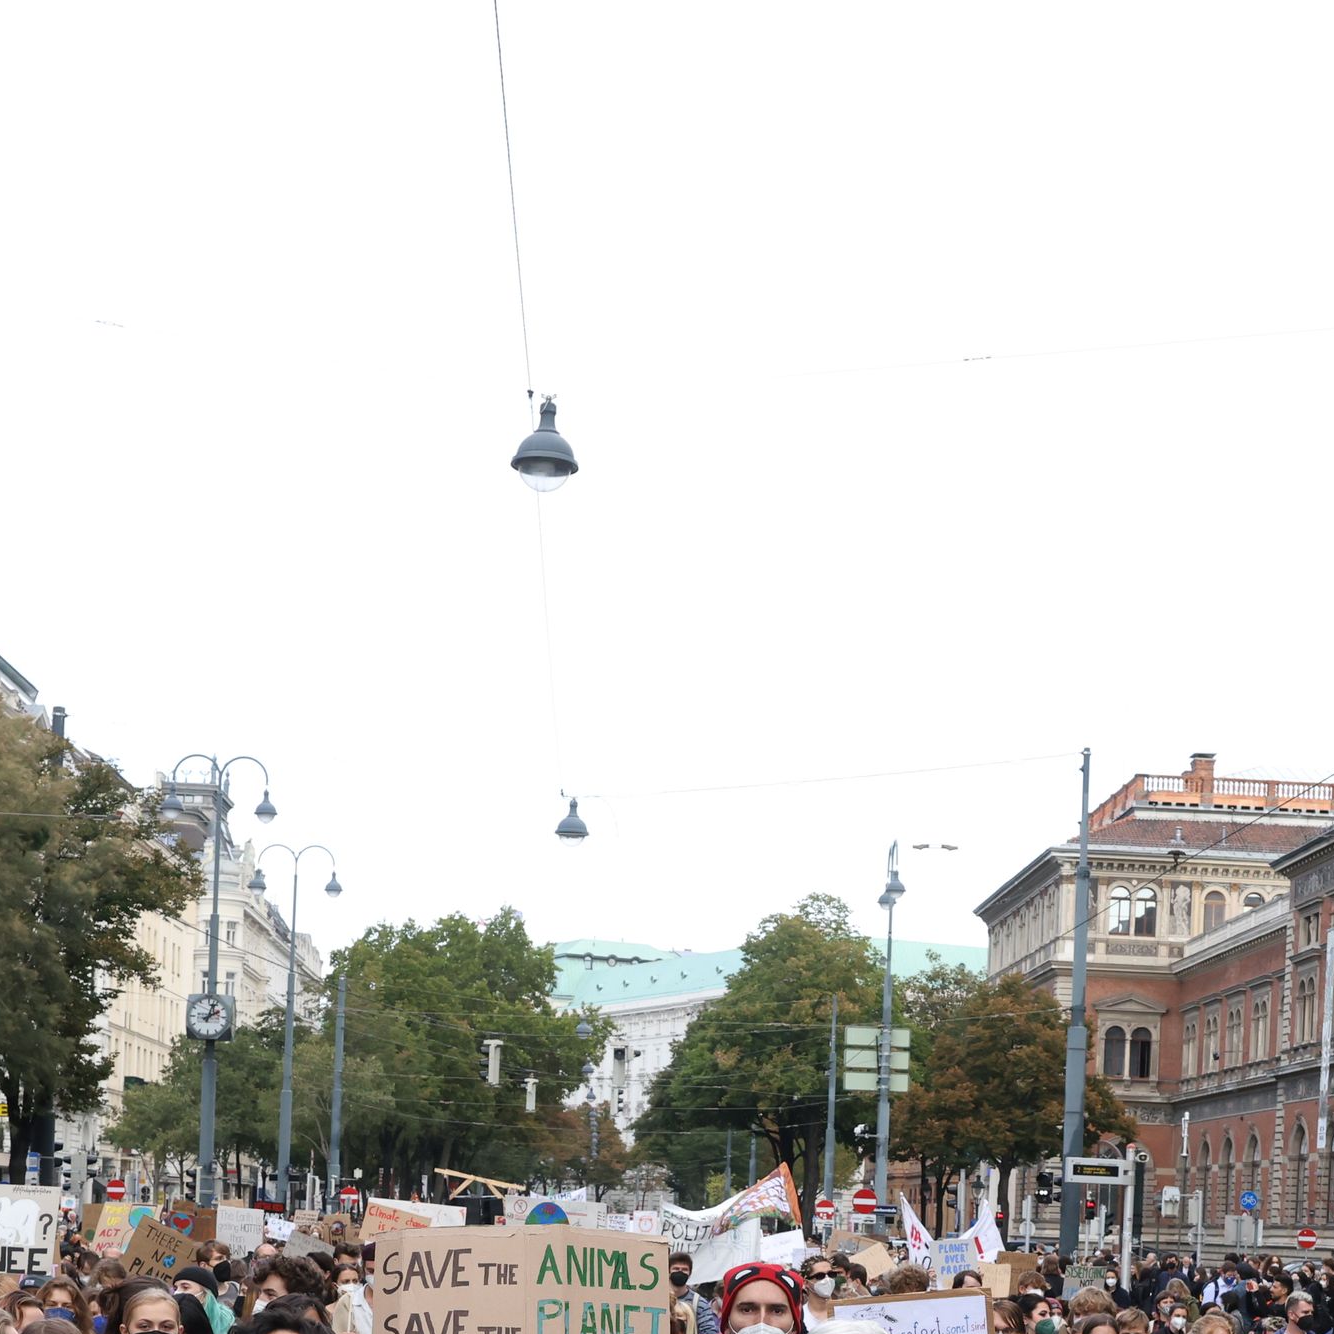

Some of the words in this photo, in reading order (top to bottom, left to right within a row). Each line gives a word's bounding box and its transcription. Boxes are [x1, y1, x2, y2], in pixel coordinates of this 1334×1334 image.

[369, 1205, 400, 1223] Climate
[145, 1224, 183, 1253] THERE
[661, 1220, 715, 1241] POLITI
[938, 1243, 969, 1255] PLANET
[944, 1254, 966, 1264] OVER
[381, 1248, 472, 1295] SAVE
[477, 1262, 519, 1286] THE
